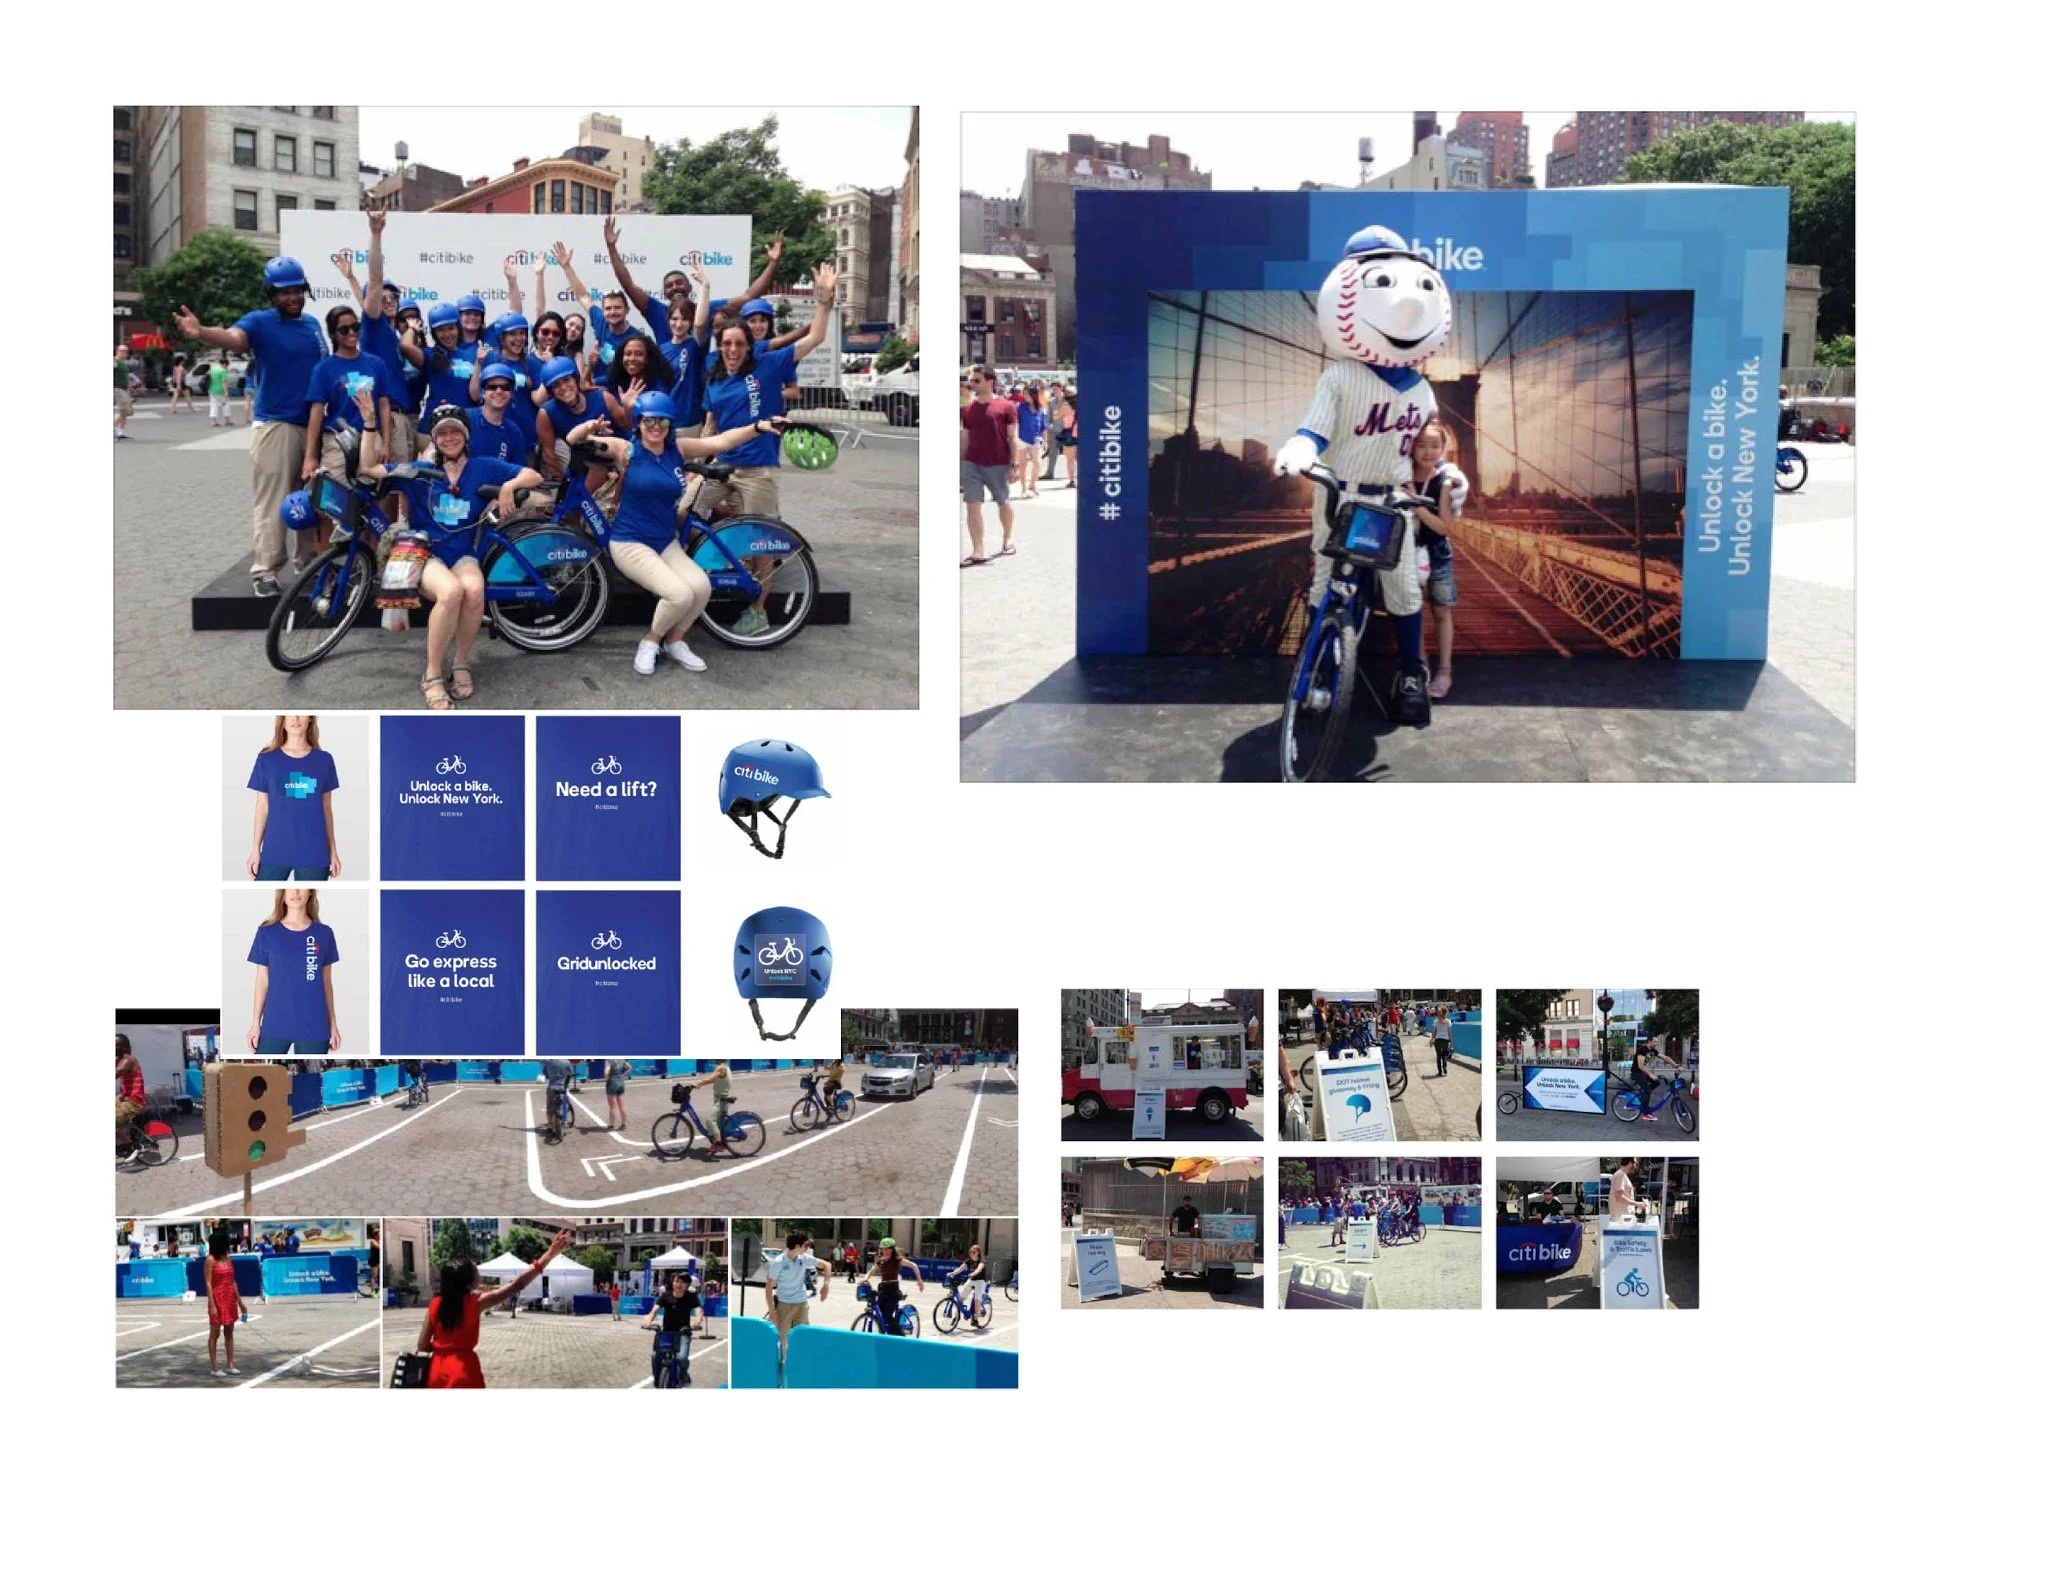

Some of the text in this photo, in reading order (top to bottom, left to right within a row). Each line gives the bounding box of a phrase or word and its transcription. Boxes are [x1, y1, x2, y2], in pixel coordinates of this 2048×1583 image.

[420, 250, 474, 264] #citibike
[530, 250, 559, 266] bke
[593, 252, 647, 264] #cbike
[1354, 402, 1422, 437] Mets
[1698, 378, 1728, 552] Unlock a bike.
[1728, 355, 1761, 576] Unlock New York.
[410, 780, 493, 792] Unlock a bike.
[556, 780, 658, 797] Need a lift?
[399, 792, 503, 805] Unlock New York.
[405, 953, 498, 973] Go express
[557, 956, 657, 971] Gridunlocked
[408, 973, 495, 988] like a local
